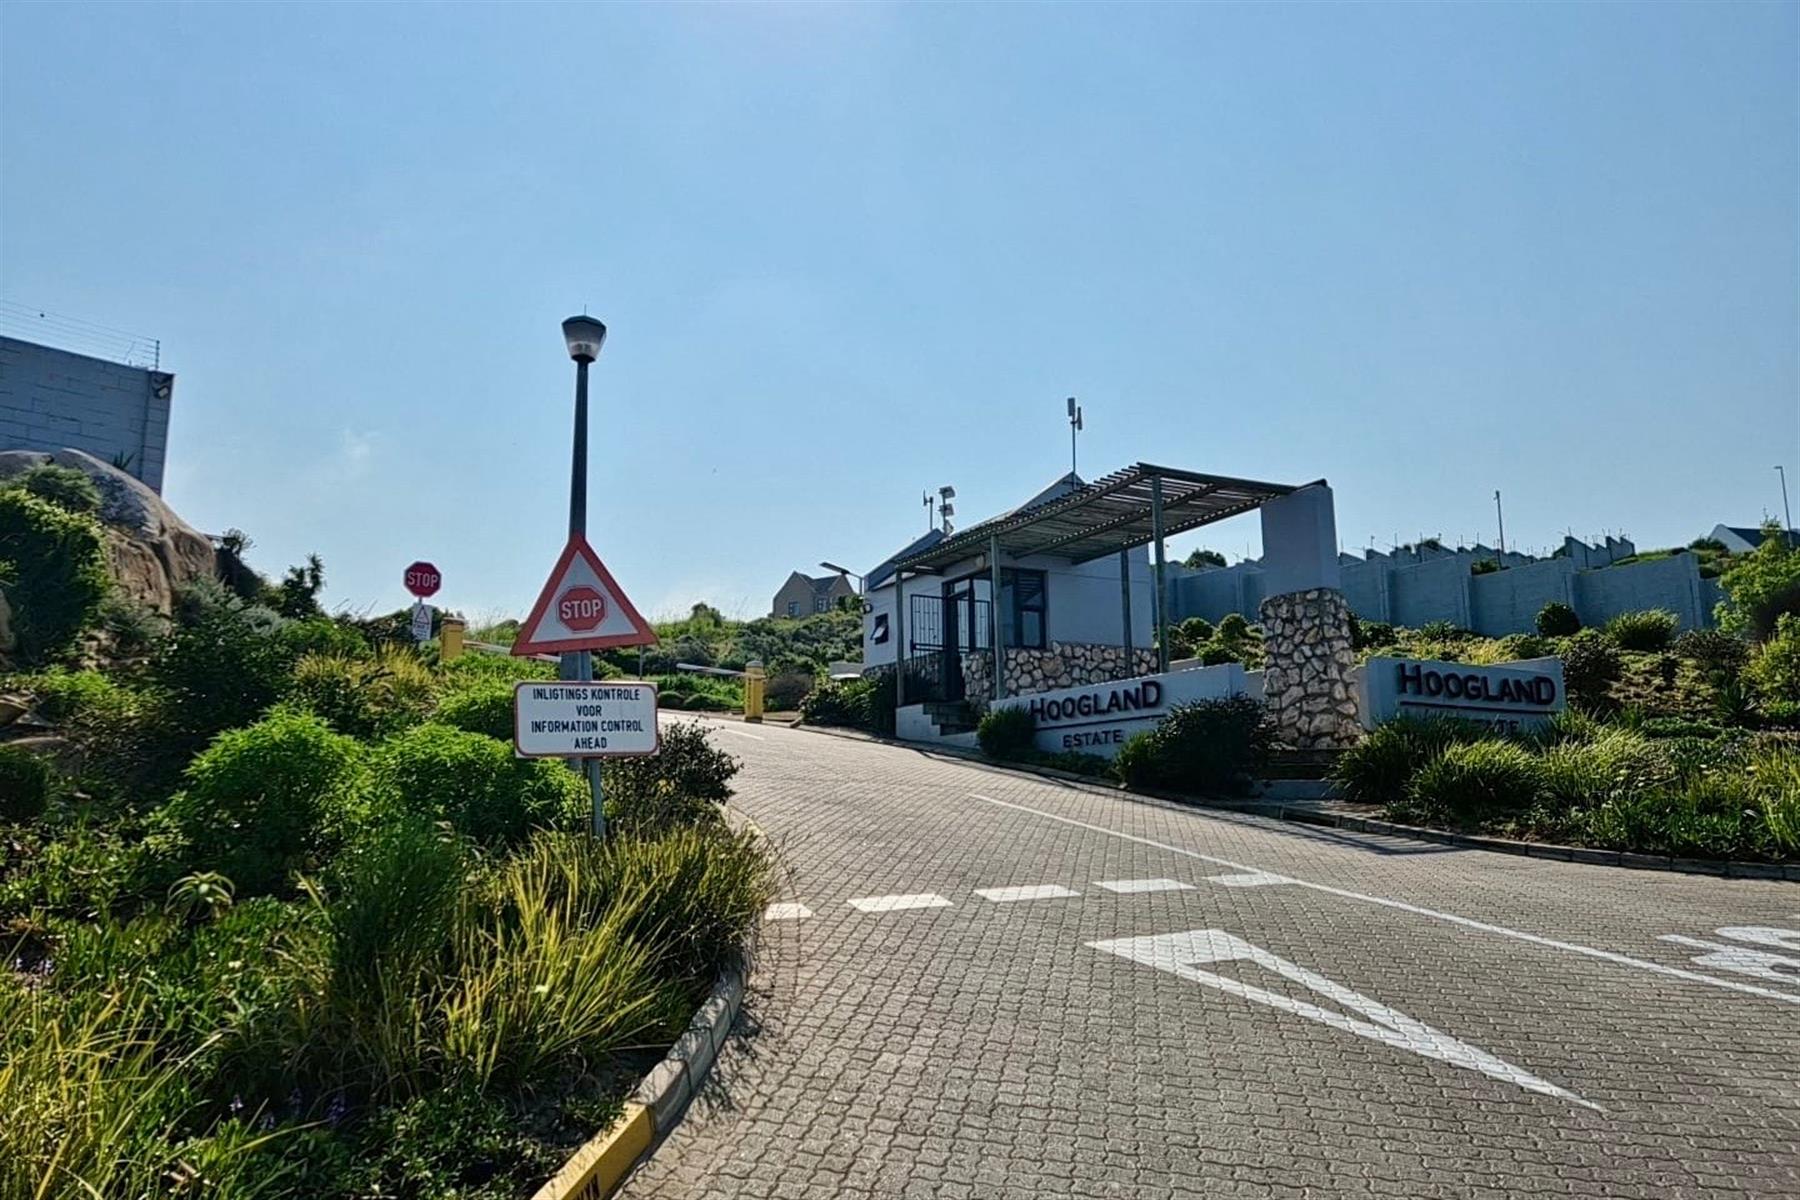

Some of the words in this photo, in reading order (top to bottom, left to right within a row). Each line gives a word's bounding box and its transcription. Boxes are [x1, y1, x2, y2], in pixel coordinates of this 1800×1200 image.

[407, 572, 438, 588] STOP
[561, 598, 602, 620] STOP
[1398, 662, 1556, 706] HOOGLAND
[532, 688, 589, 701] INLIGTINGS
[591, 688, 641, 701] KONTROLE
[1030, 680, 1164, 722] HOOGLAND
[576, 704, 602, 717] VOOR
[531, 720, 598, 733] INFORMATION
[601, 719, 644, 732] CONTROL
[574, 736, 608, 750] AHEAD
[1062, 729, 1123, 749] ESTATE
